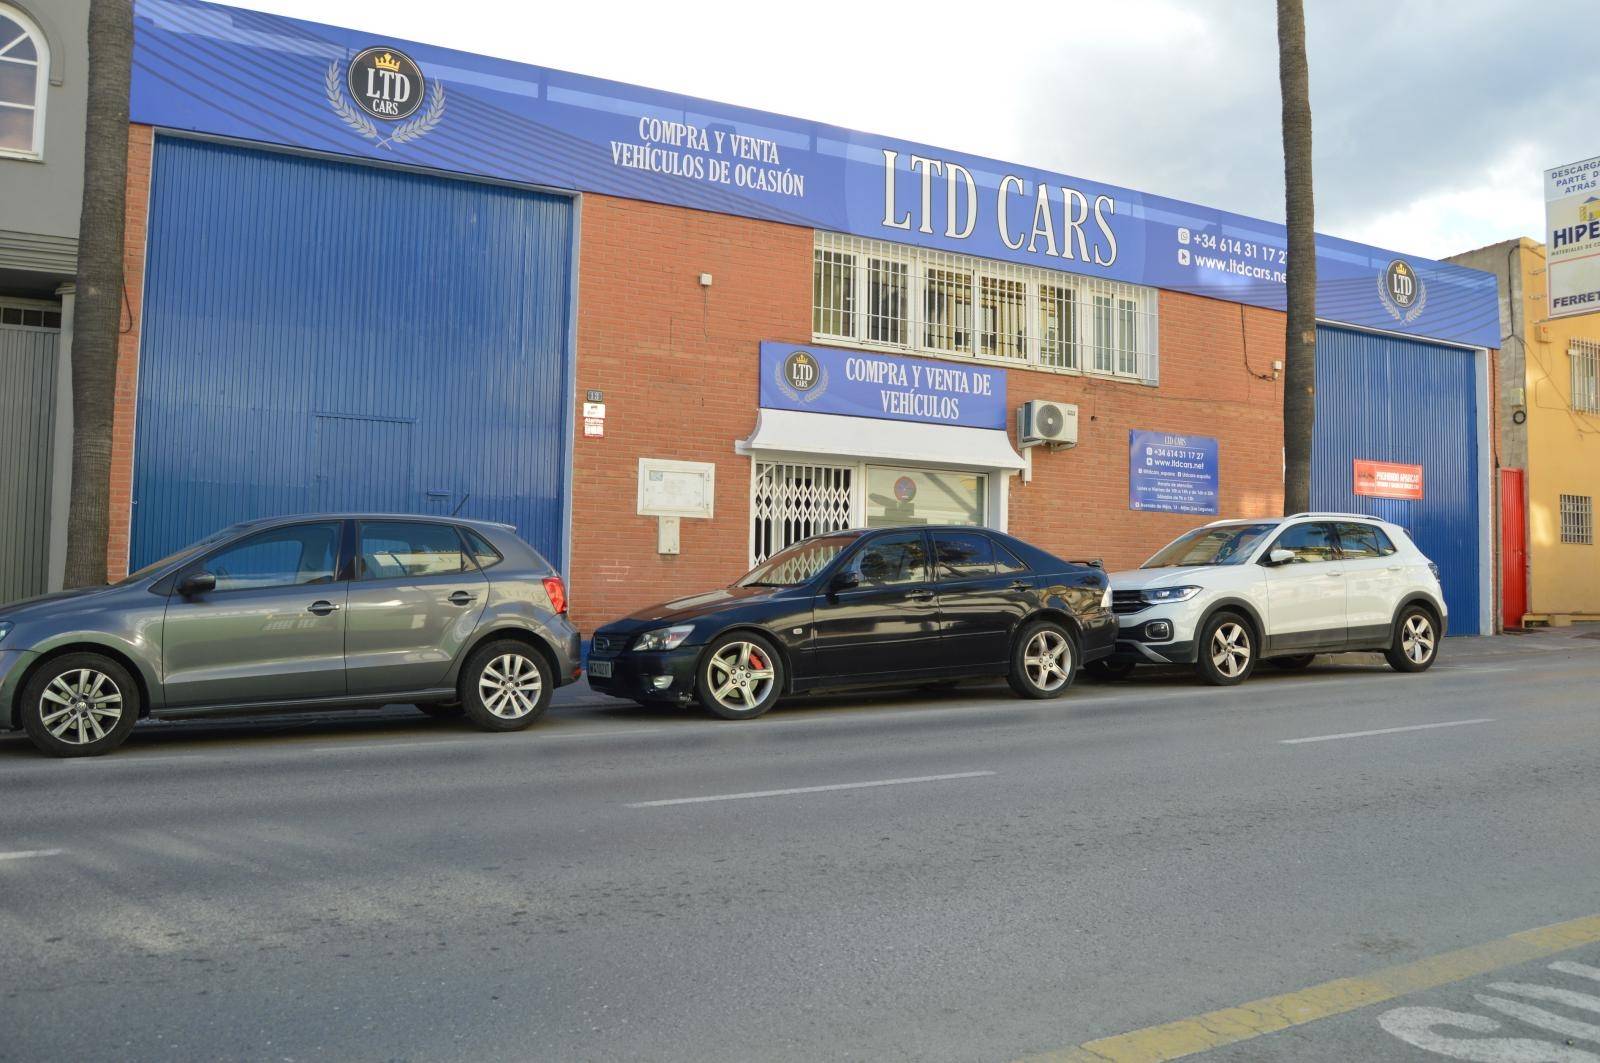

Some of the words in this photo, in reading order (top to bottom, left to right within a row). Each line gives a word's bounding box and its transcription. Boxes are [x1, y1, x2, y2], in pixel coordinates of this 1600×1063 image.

[366, 68, 411, 102] LTD
[372, 99, 399, 115] CARS
[639, 116, 709, 152] COMPRA
[714, 130, 726, 154] Y
[730, 133, 780, 165] VENTA
[610, 141, 705, 180] VEHÍCULOS
[708, 158, 730, 185] DE
[735, 163, 804, 198] OCASIÓN
[1556, 173, 1586, 187] PARTE
[881, 149, 978, 239] LTD
[996, 174, 1118, 268] CARS
[1194, 234, 1217, 250] +34
[1220, 238, 1242, 255] 614
[1244, 243, 1257, 259] 31
[1262, 246, 1276, 262] 17
[1279, 251, 1287, 265] 2
[1195, 255, 1287, 284] www.ltdcars.ne
[1393, 273, 1412, 295] LTD
[792, 363, 813, 380] LTD
[846, 357, 908, 387] COMPRA
[912, 365, 922, 388] Y
[925, 367, 969, 394] VENTA
[973, 372, 991, 396] DE
[880, 389, 959, 420] VEHÍCULOS
[1166, 449, 1178, 458] 614
[1179, 451, 1187, 459] 31
[1196, 452, 1204, 460] 27
